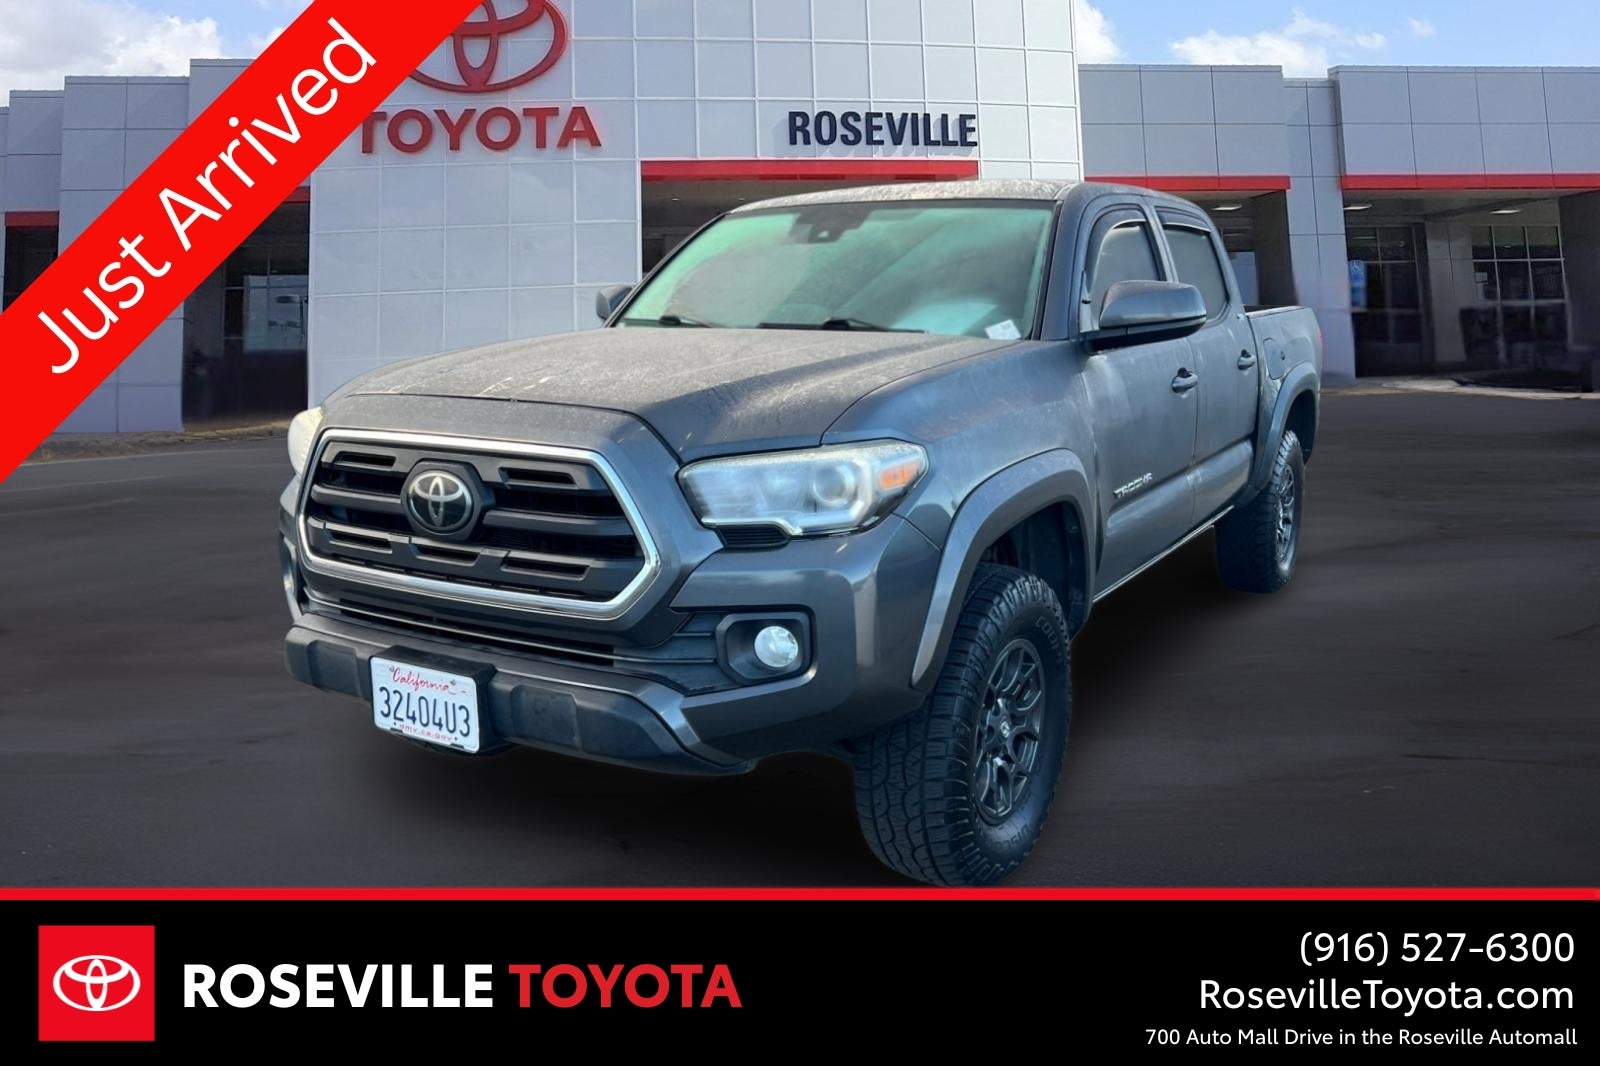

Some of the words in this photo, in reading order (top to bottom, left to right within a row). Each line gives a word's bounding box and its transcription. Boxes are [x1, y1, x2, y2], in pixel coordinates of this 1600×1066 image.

[361, 106, 602, 153] TOYOTA
[788, 111, 978, 147] ROSEVILLE
[391, 666, 452, 692] California
[379, 686, 470, 737] 32404U3
